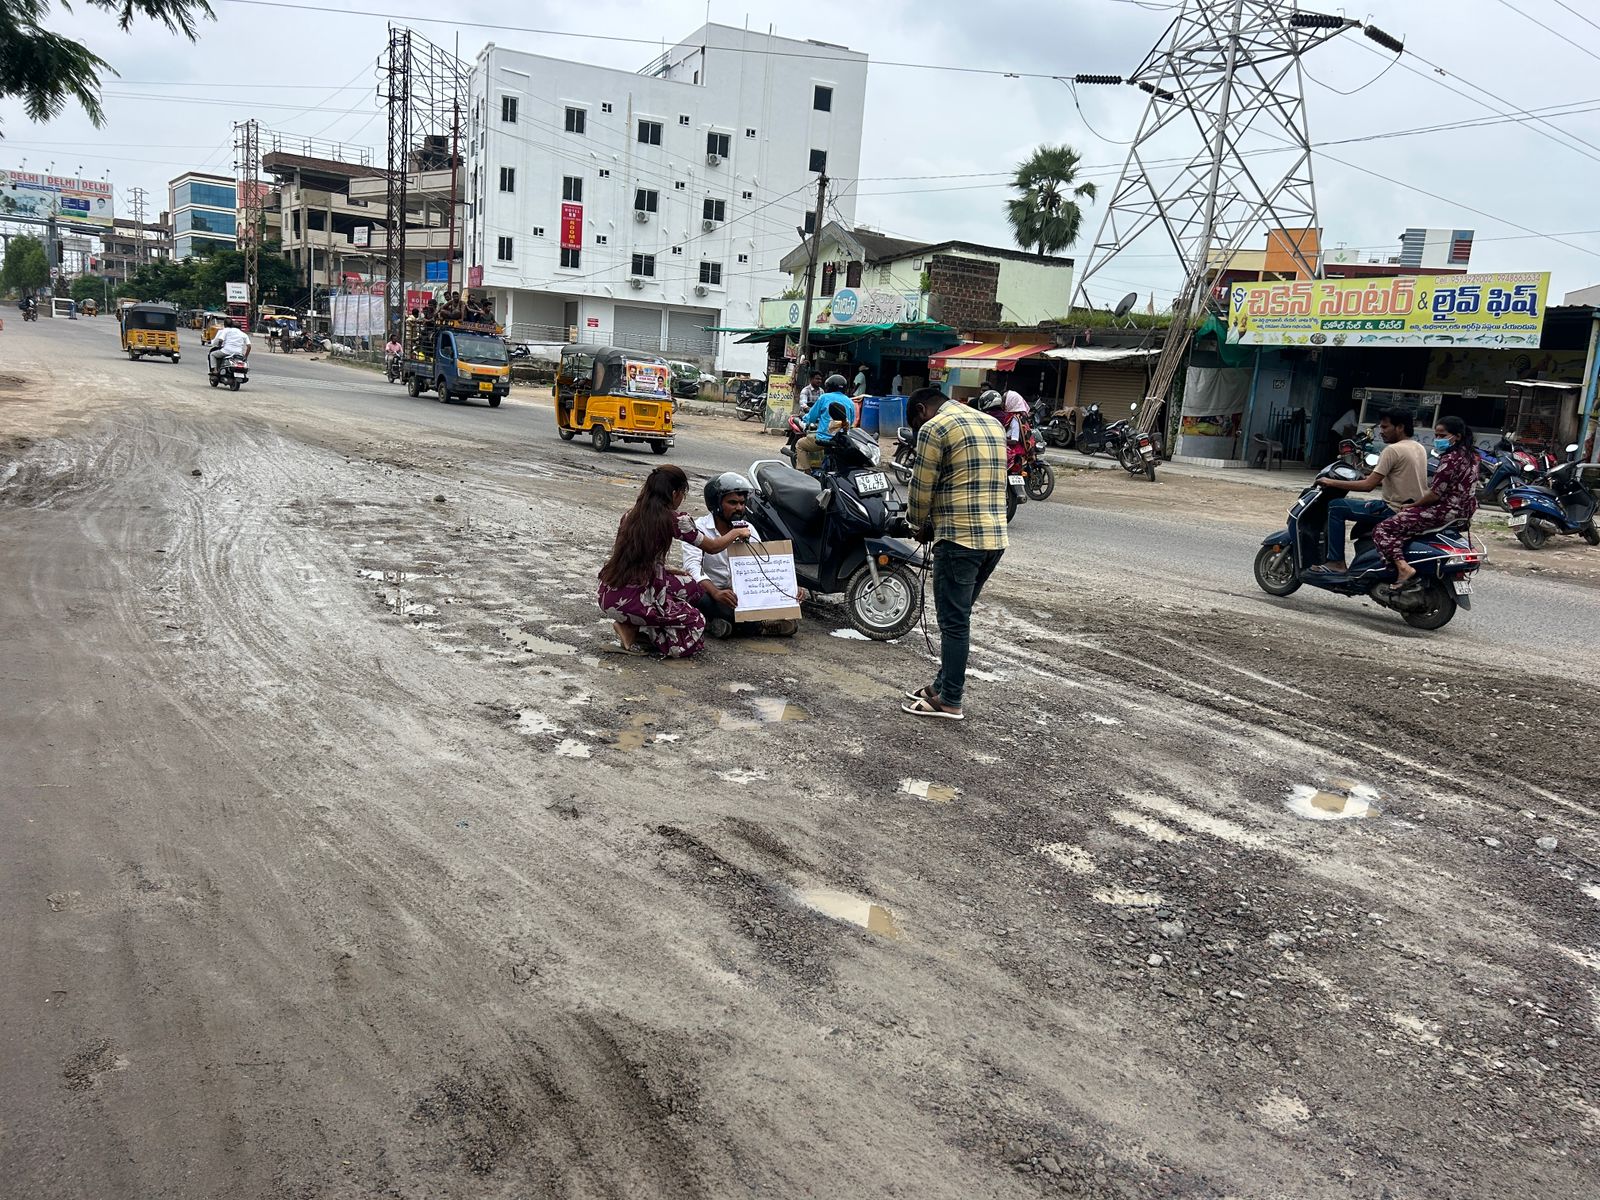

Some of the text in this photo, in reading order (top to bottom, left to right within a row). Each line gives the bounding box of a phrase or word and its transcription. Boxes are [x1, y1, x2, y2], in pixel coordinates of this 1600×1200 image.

[10, 171, 38, 182] DELHI
[47, 176, 75, 187] DELHI
[82, 181, 109, 192] DELHI
[1247, 282, 1314, 316] చికెన్
[1319, 279, 1416, 316] సెంటర్
[1417, 290, 1428, 311] &
